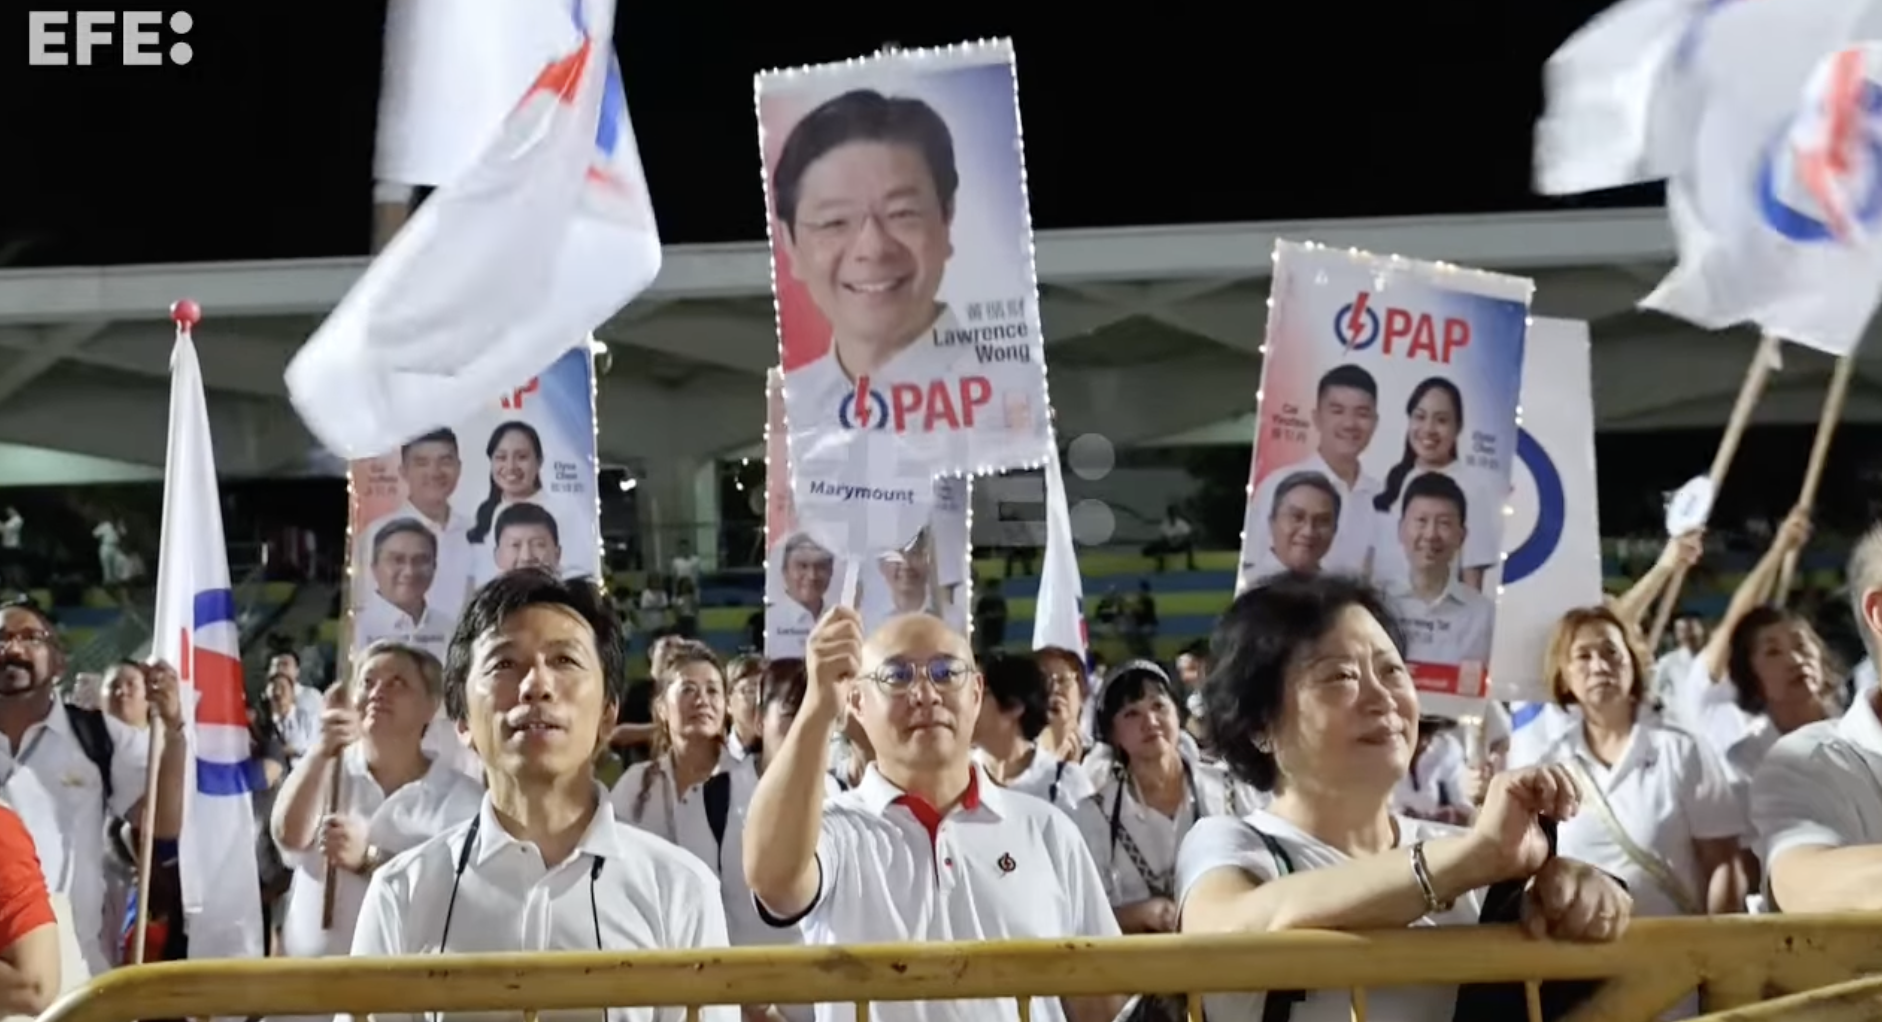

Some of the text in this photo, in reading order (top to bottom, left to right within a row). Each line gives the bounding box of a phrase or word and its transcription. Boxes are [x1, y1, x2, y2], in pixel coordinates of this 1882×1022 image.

[932, 322, 1029, 347] Lawrence
[1382, 307, 1472, 364] PAP
[975, 343, 1031, 364] Wong
[890, 375, 993, 433] PAP
[810, 480, 914, 505] Marymount
